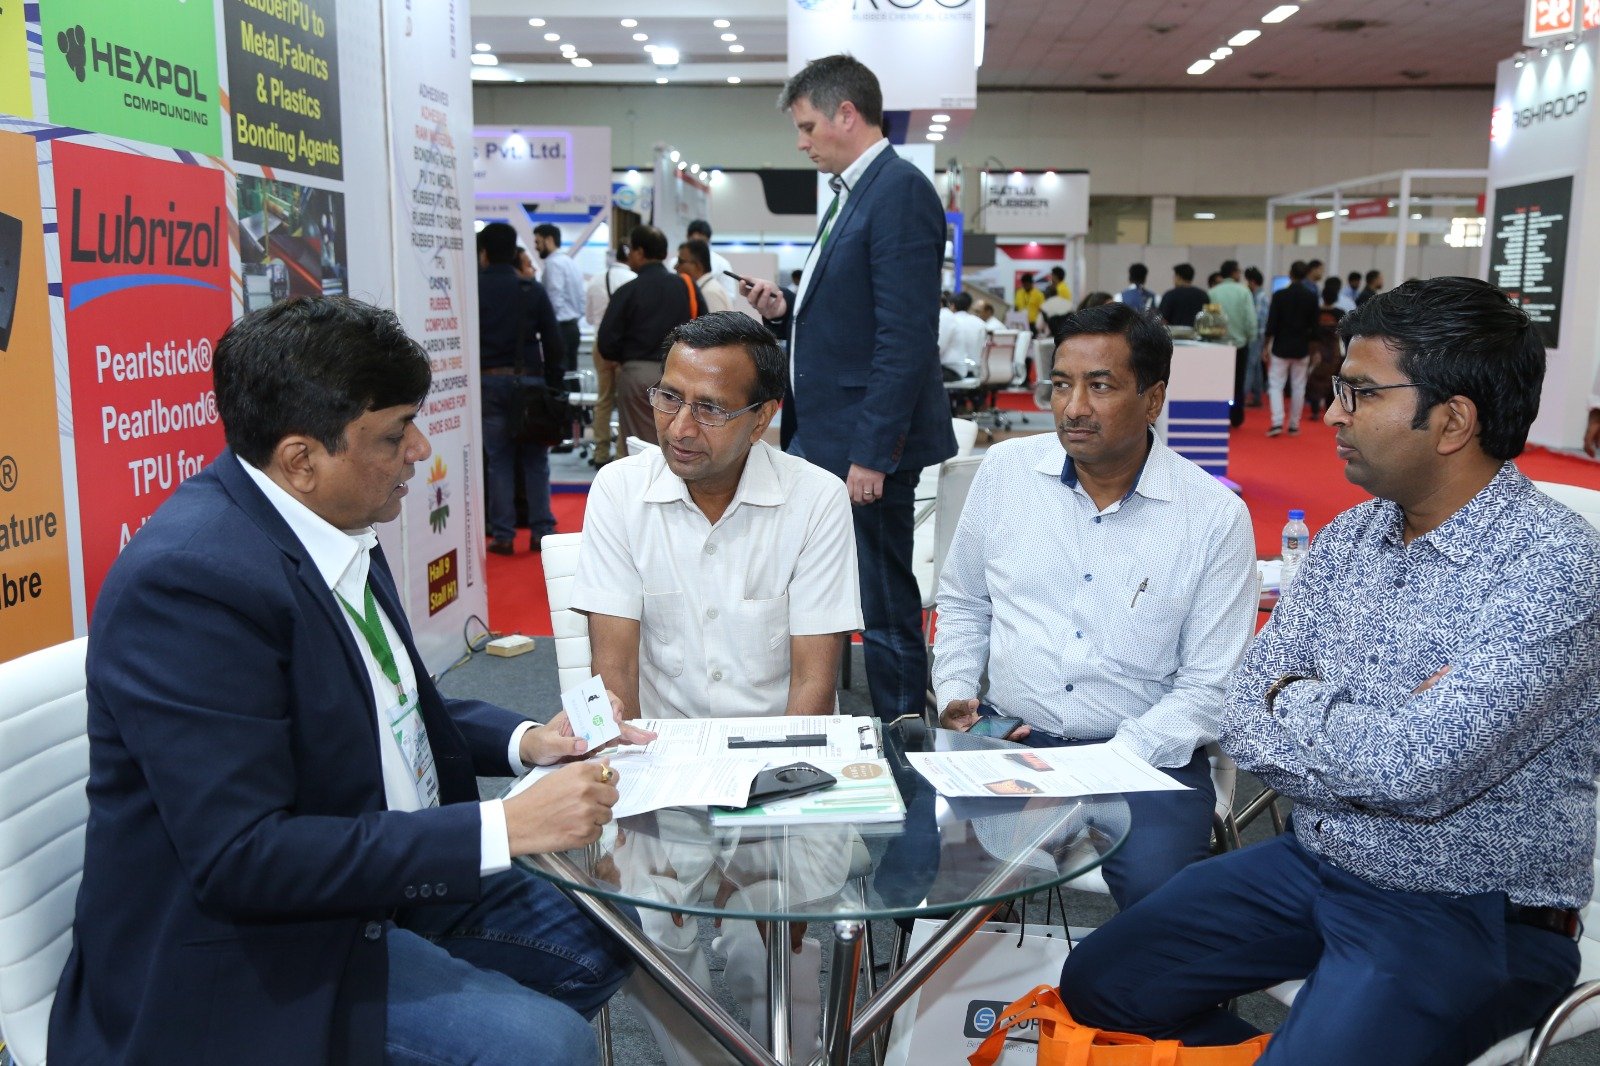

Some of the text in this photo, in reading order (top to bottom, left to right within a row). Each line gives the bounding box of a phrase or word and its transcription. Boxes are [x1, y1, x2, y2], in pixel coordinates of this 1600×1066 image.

[312, 9, 325, 38] to
[91, 37, 208, 102] HEXPOL
[124, 93, 208, 126] COMPOUNDING
[256, 72, 321, 120] & Plastics
[236, 112, 340, 167] Bonding Agents
[530, 143, 567, 159] Ltd.
[70, 188, 220, 267] Lubrizol
[128, 453, 173, 497] TPU
[429, 556, 451, 584] Hall 9
[430, 584, 447, 611] Stall
